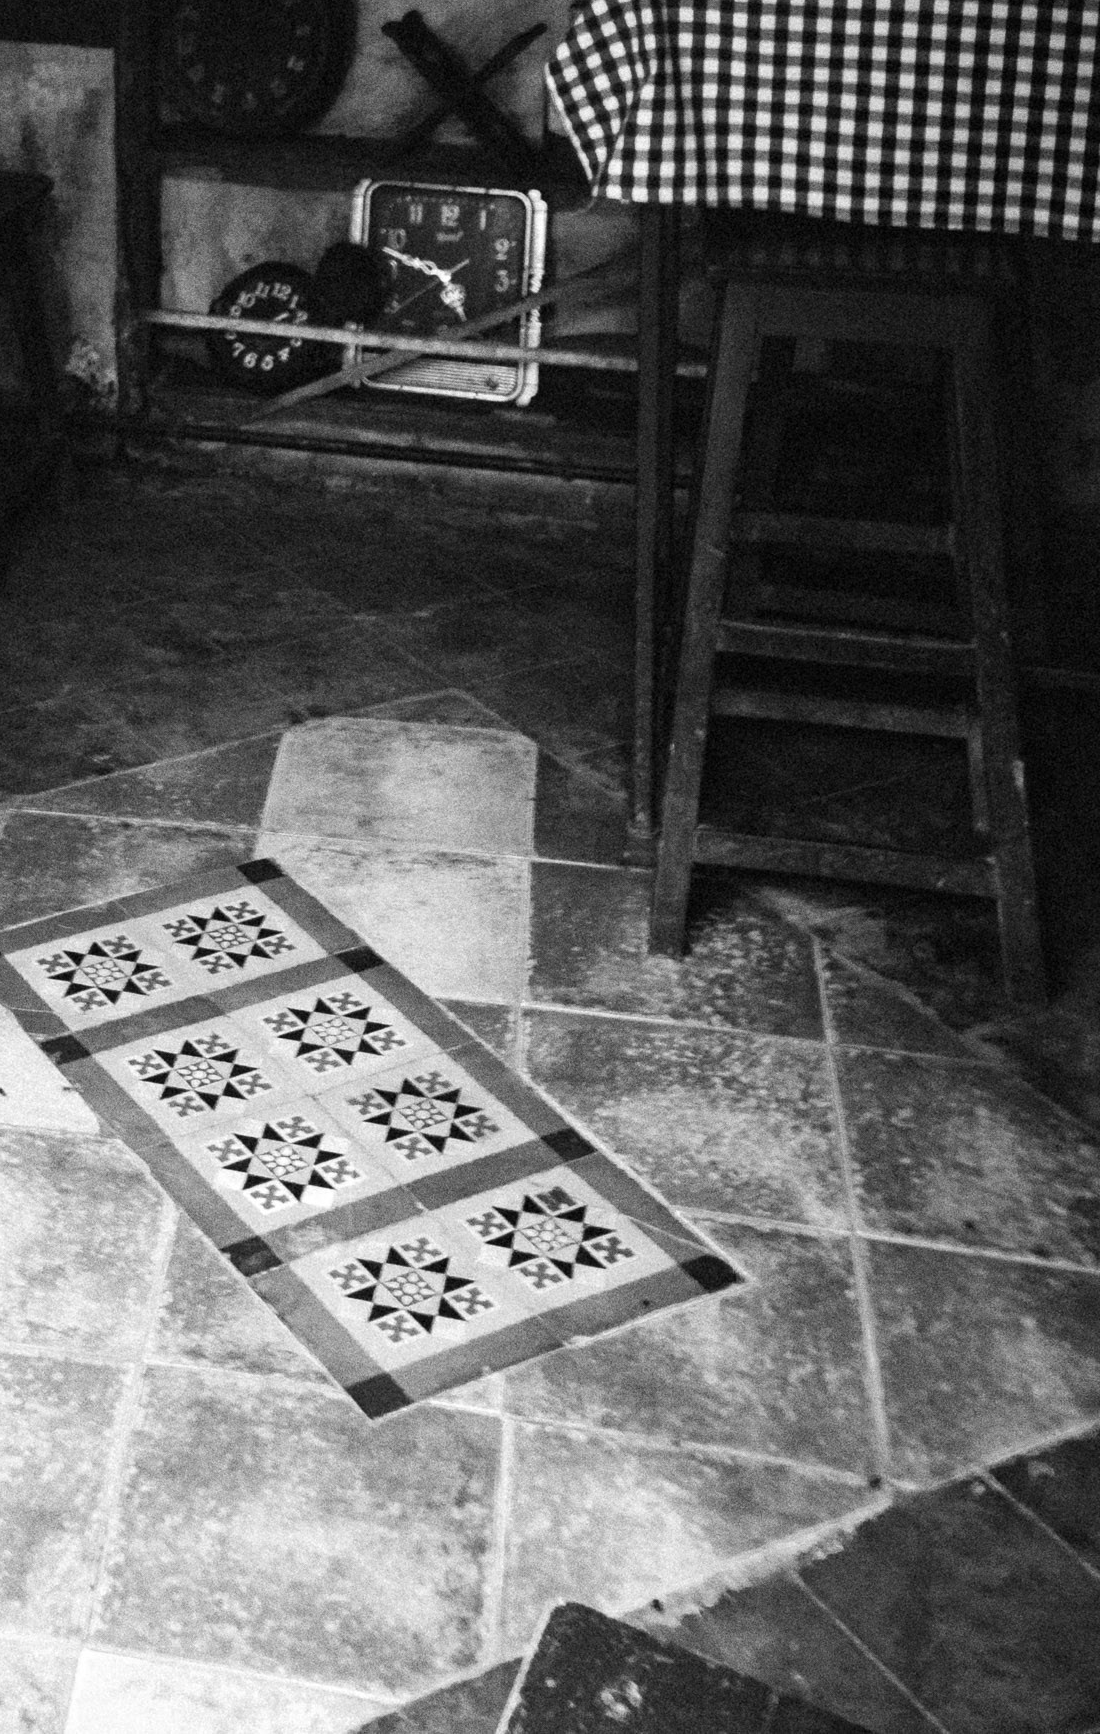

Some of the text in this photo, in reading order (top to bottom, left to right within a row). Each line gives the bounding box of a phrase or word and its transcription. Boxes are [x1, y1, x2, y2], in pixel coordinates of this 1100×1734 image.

[440, 204, 461, 227] 12
[494, 238, 511, 261] 2
[272, 281, 293, 301] 12
